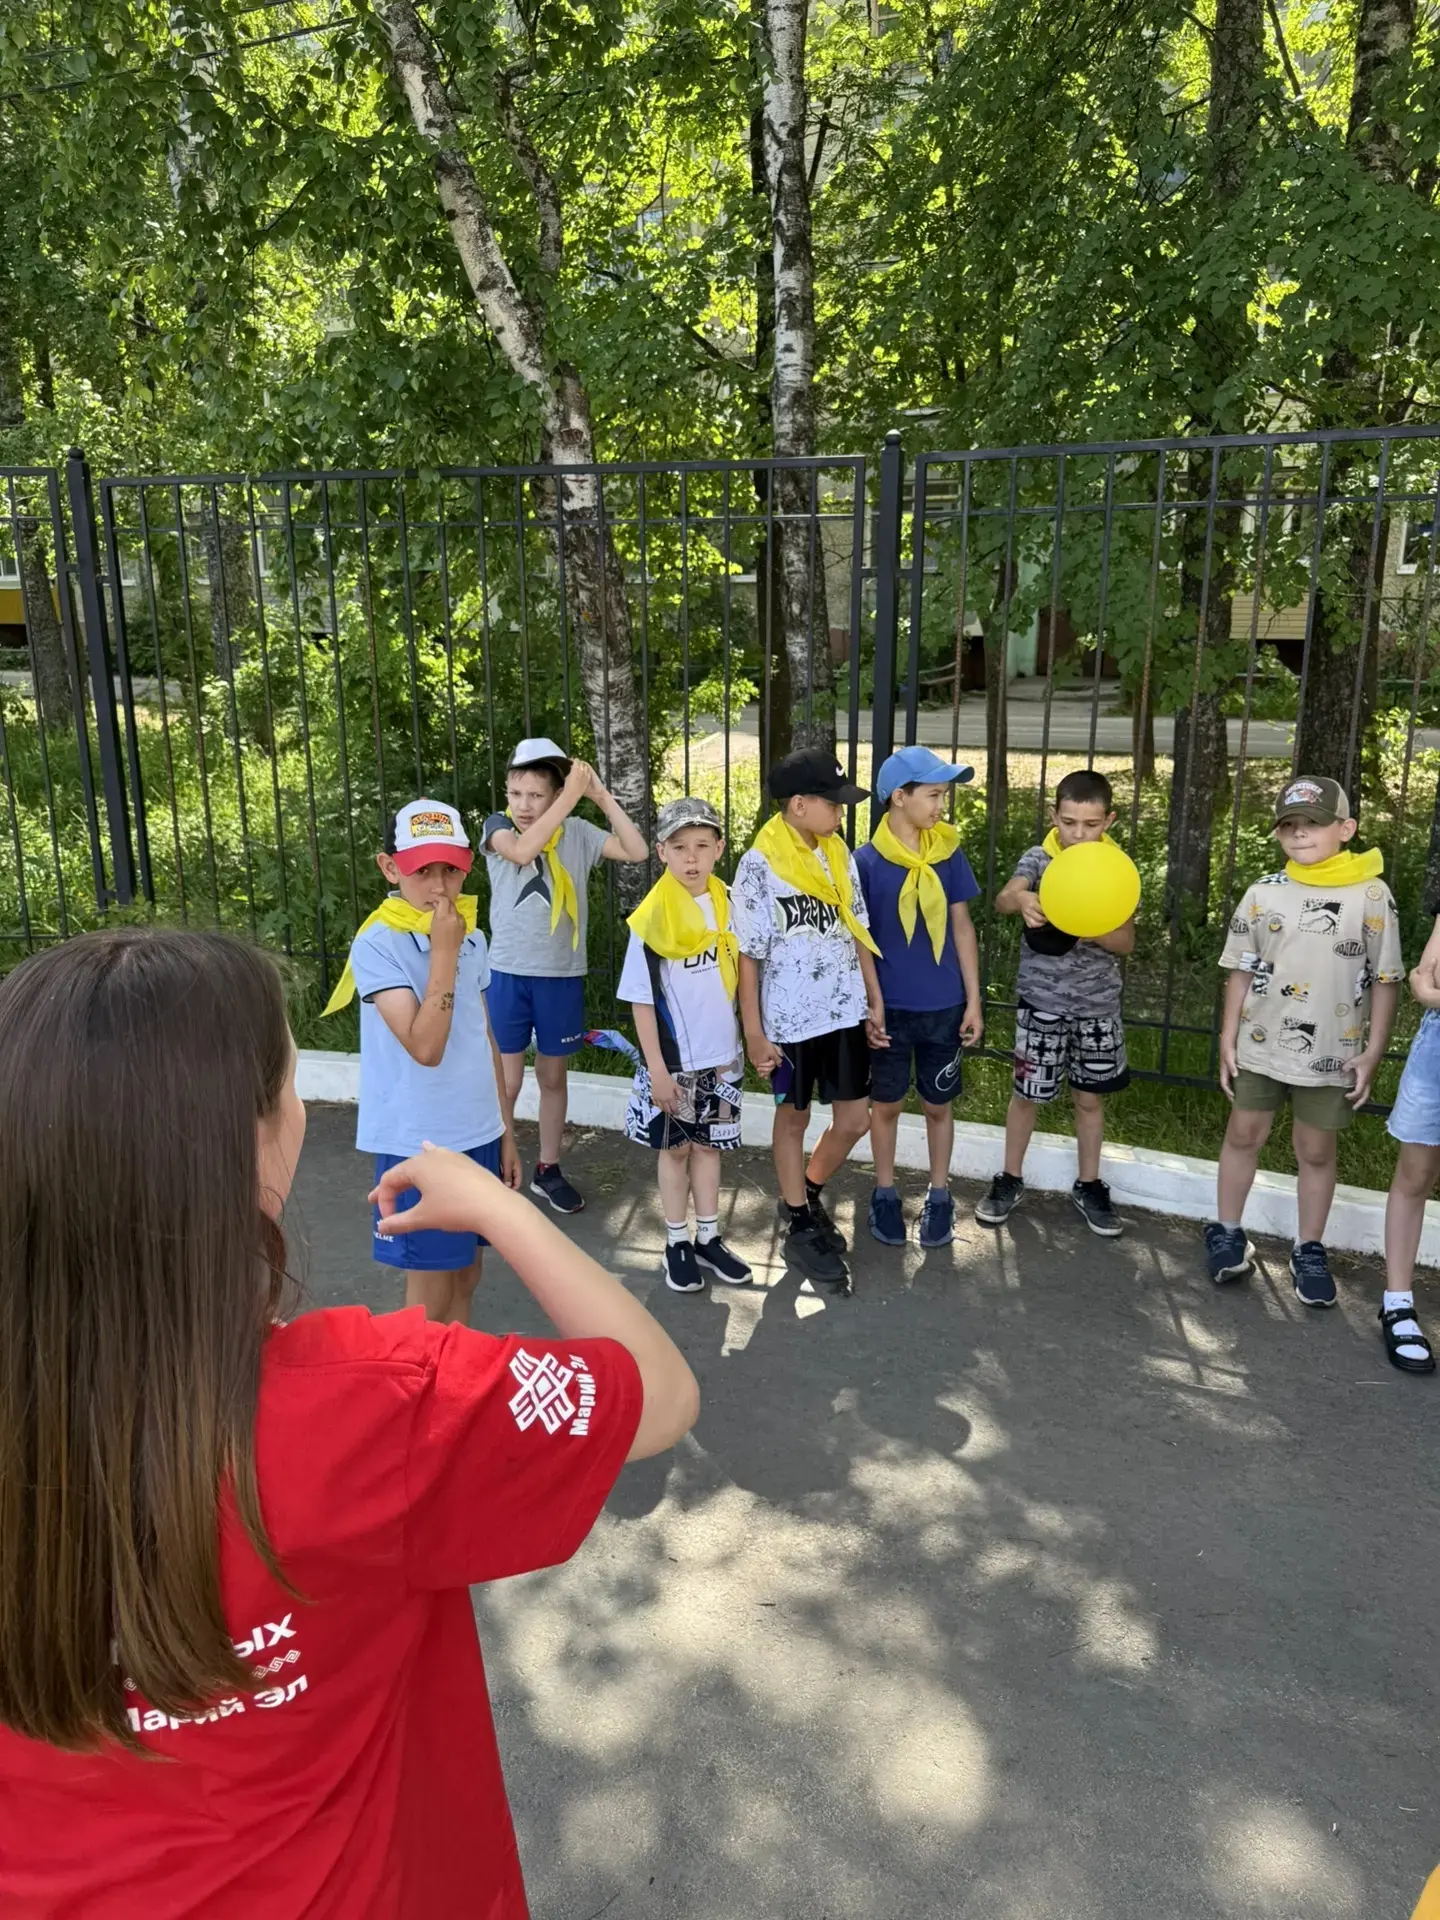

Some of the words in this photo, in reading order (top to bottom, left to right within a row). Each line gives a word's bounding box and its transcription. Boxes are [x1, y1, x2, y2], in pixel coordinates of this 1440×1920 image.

[775, 893, 839, 935] CREA
[569, 1373, 596, 1436] Марий
[254, 1675, 309, 1709] Эл
